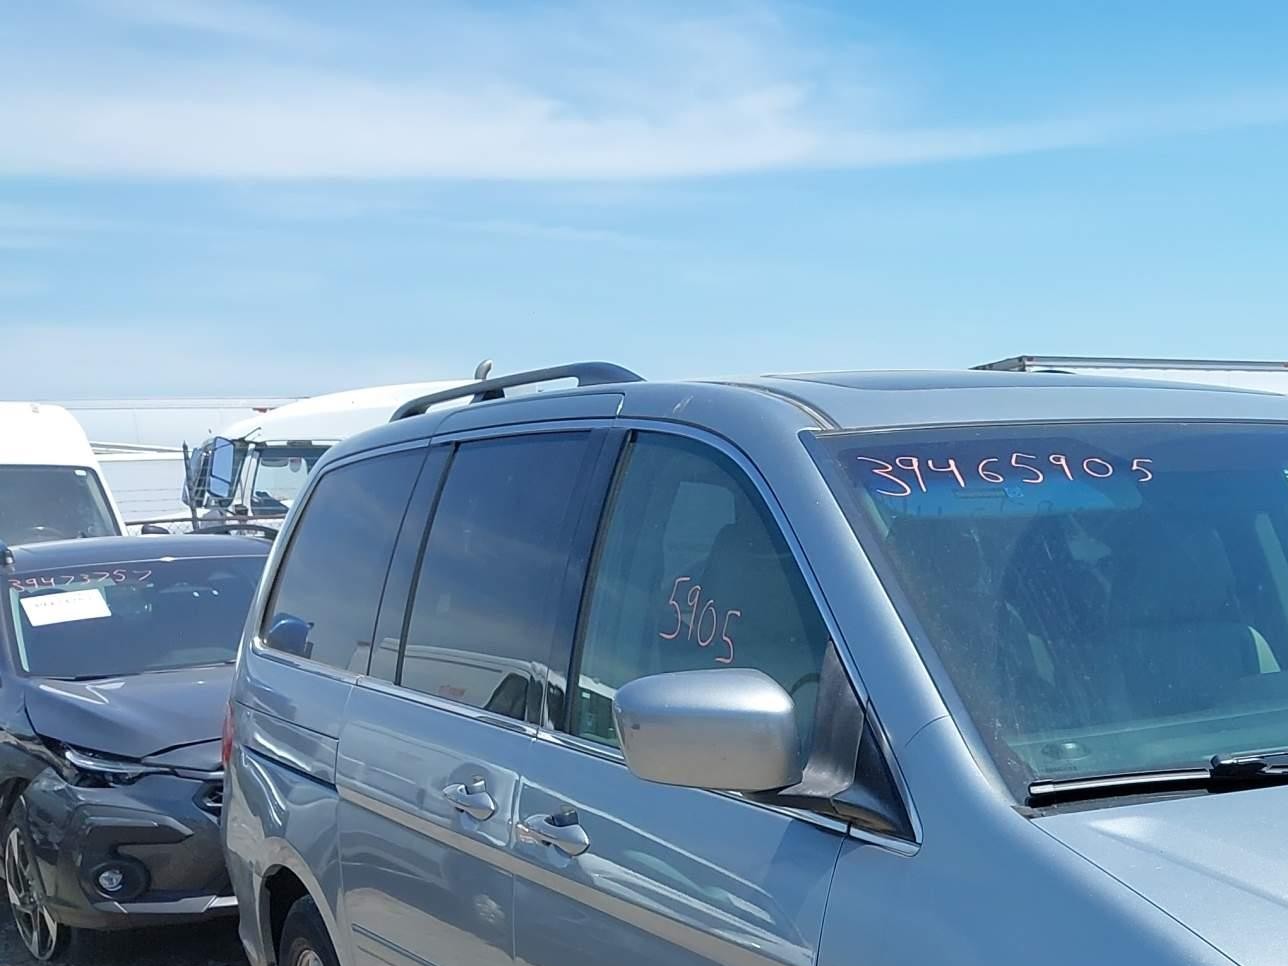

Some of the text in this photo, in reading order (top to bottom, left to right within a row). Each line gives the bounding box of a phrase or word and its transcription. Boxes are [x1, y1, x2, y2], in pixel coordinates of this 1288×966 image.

[856, 453, 1153, 496] 39465905
[8, 569, 152, 593] 39473757
[659, 576, 741, 663] 5905
